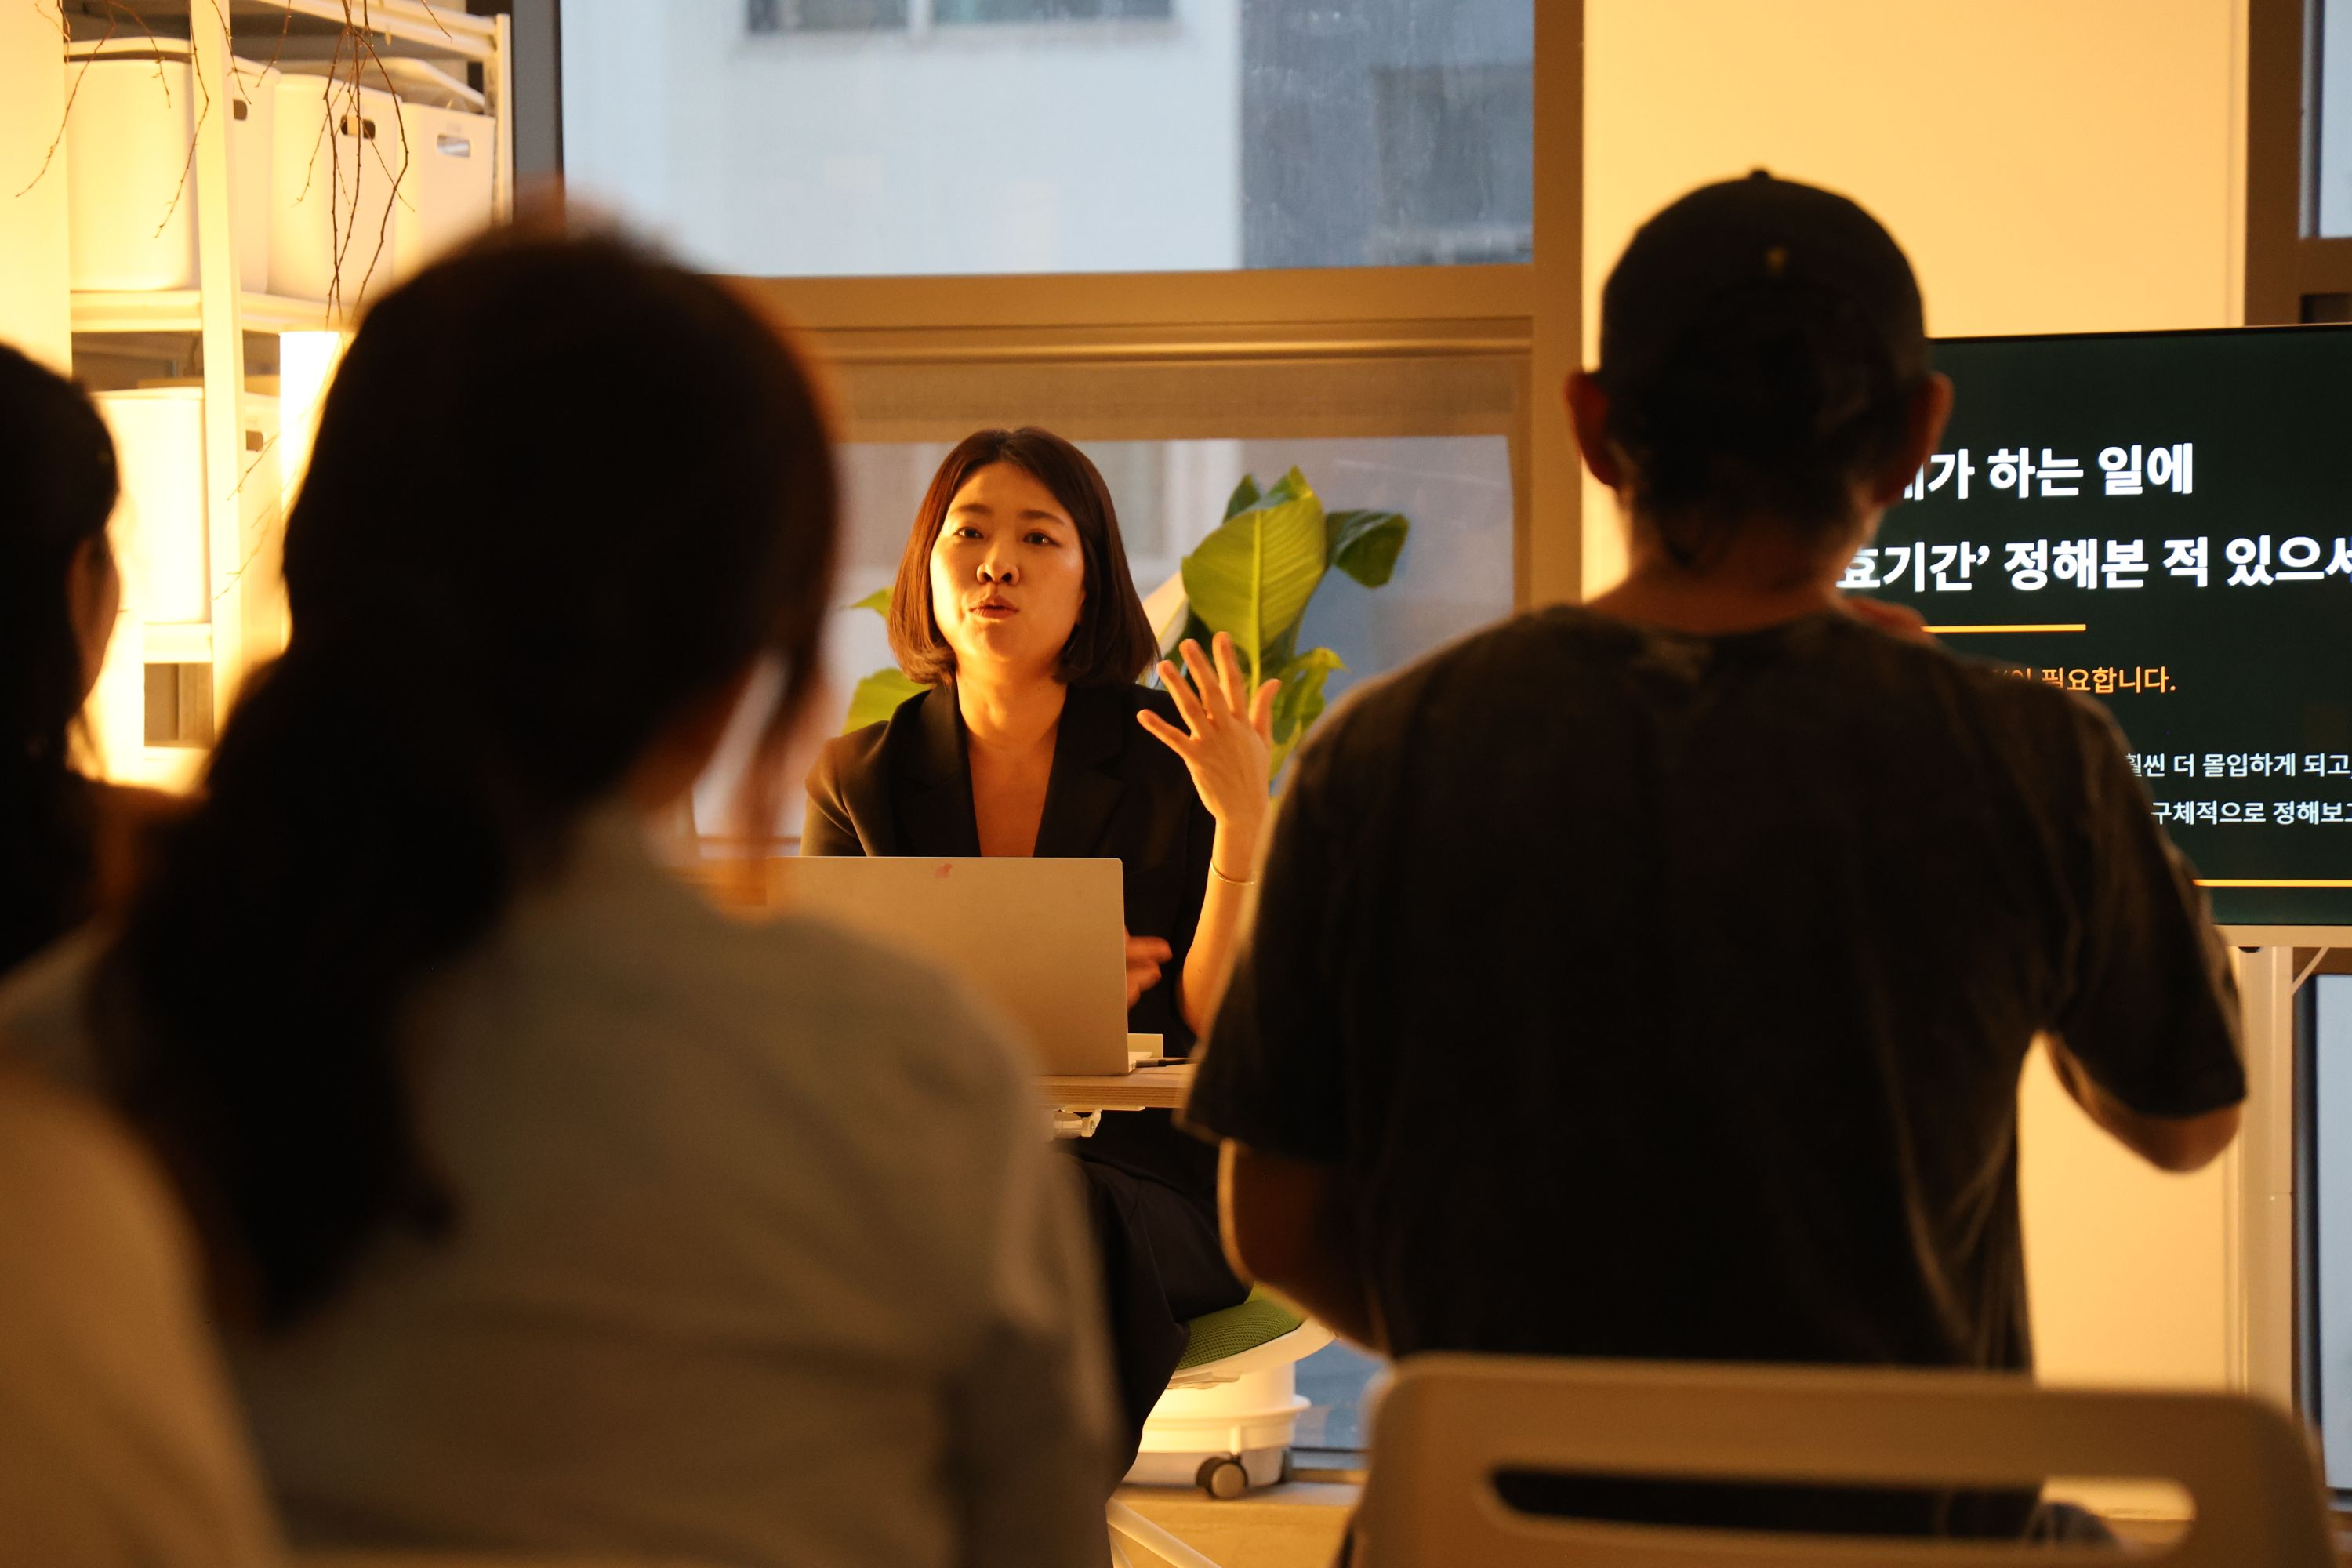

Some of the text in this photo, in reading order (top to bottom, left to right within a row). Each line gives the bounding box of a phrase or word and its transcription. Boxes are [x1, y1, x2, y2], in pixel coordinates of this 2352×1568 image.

[1987, 447, 2084, 499] 하는
[2097, 442, 2193, 496] 일에
[2004, 538, 2150, 591] 정해본
[2162, 536, 2209, 588] 적
[2173, 753, 2194, 778] 더
[2202, 753, 2296, 778] 몰입하게
[2151, 800, 2267, 826] 구체적으로
